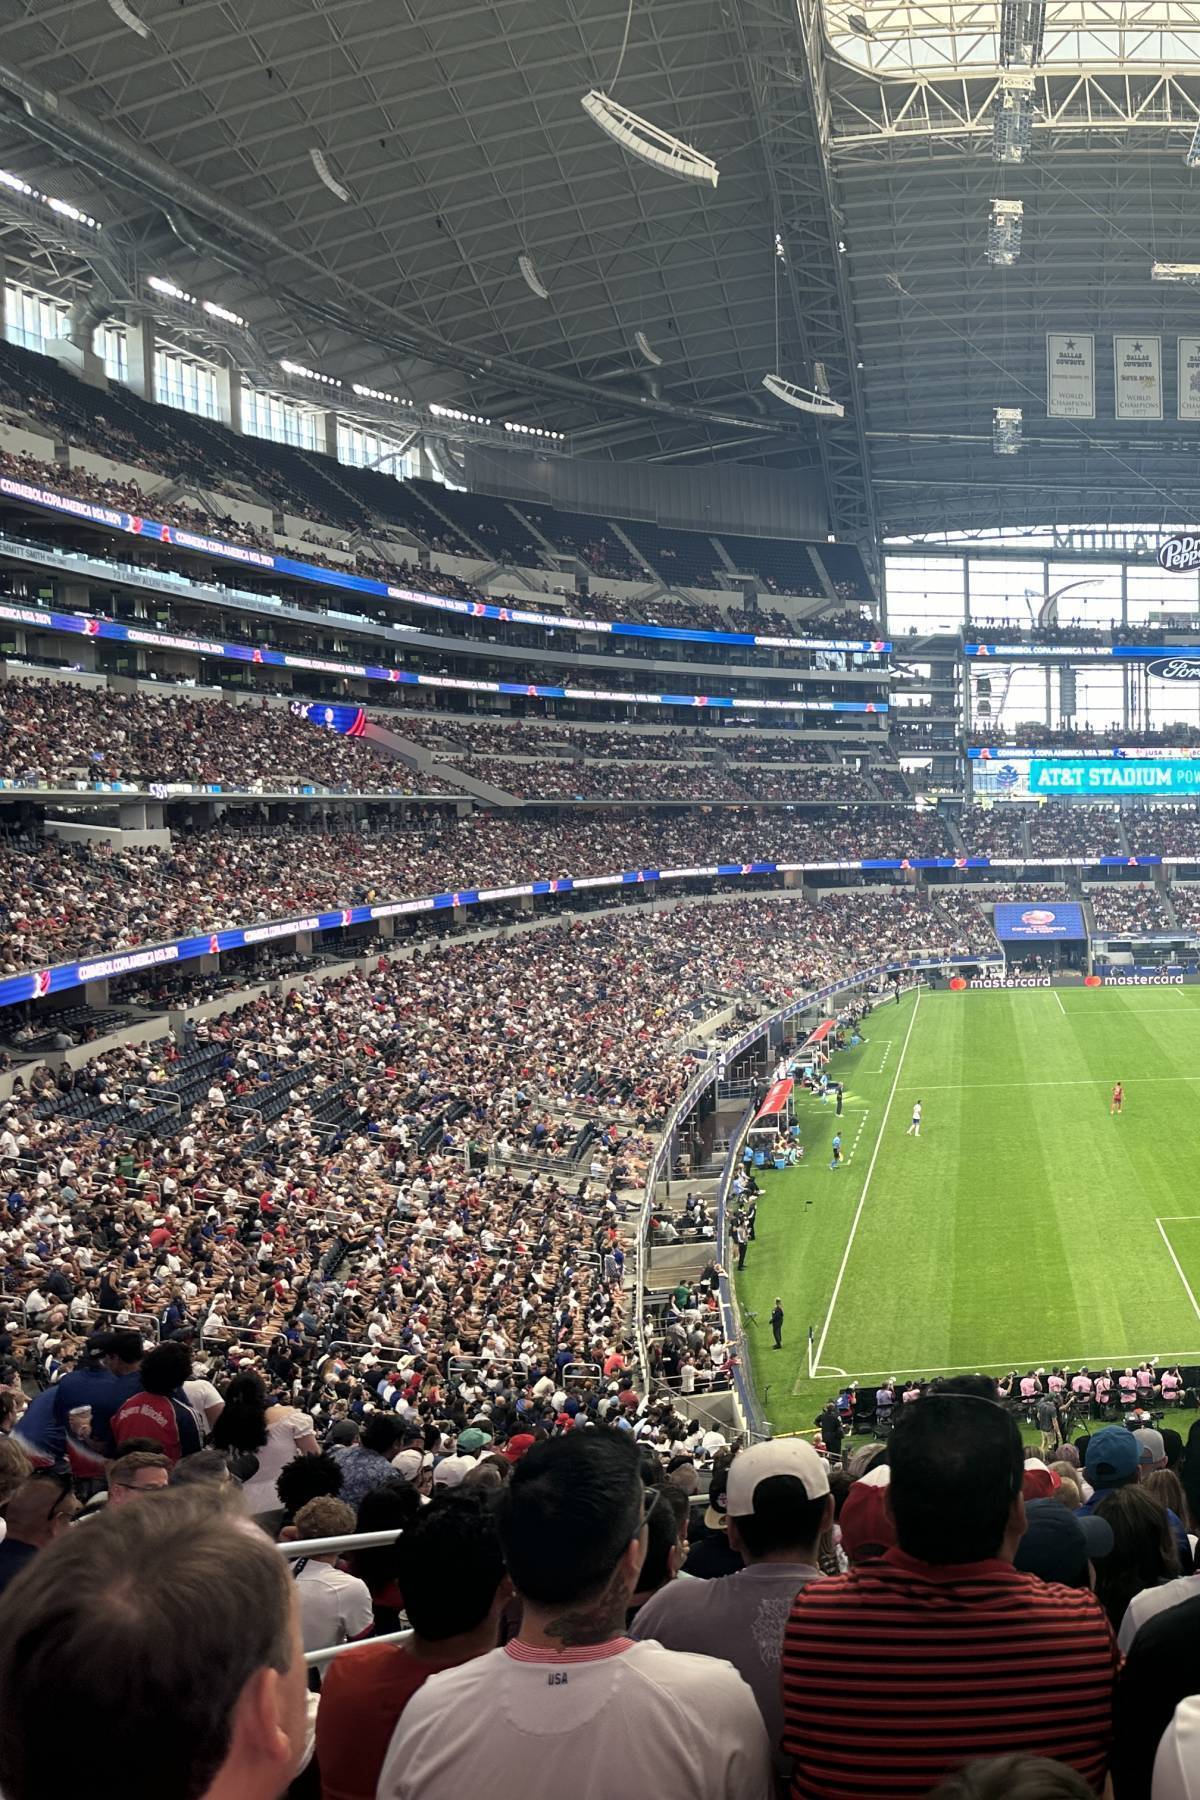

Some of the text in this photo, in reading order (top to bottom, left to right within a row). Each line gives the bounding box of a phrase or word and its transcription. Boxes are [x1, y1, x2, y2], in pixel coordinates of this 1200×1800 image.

[1, 478, 121, 525] CONMEBOL COPA AMERICA USA 2024
[26, 549, 45, 561] SMITH
[995, 647, 1112, 655] CONMEBOL COPA AMERICA USA 2024
[997, 749, 1114, 757] CONMEBOL COPA AMERICA USA 2024
[1038, 767, 1082, 786] AT&T
[1089, 767, 1173, 786] STADIUM
[970, 977, 1051, 988] mastercard
[1104, 974, 1183, 985] mastercard
[548, 1672, 568, 1685] USA
